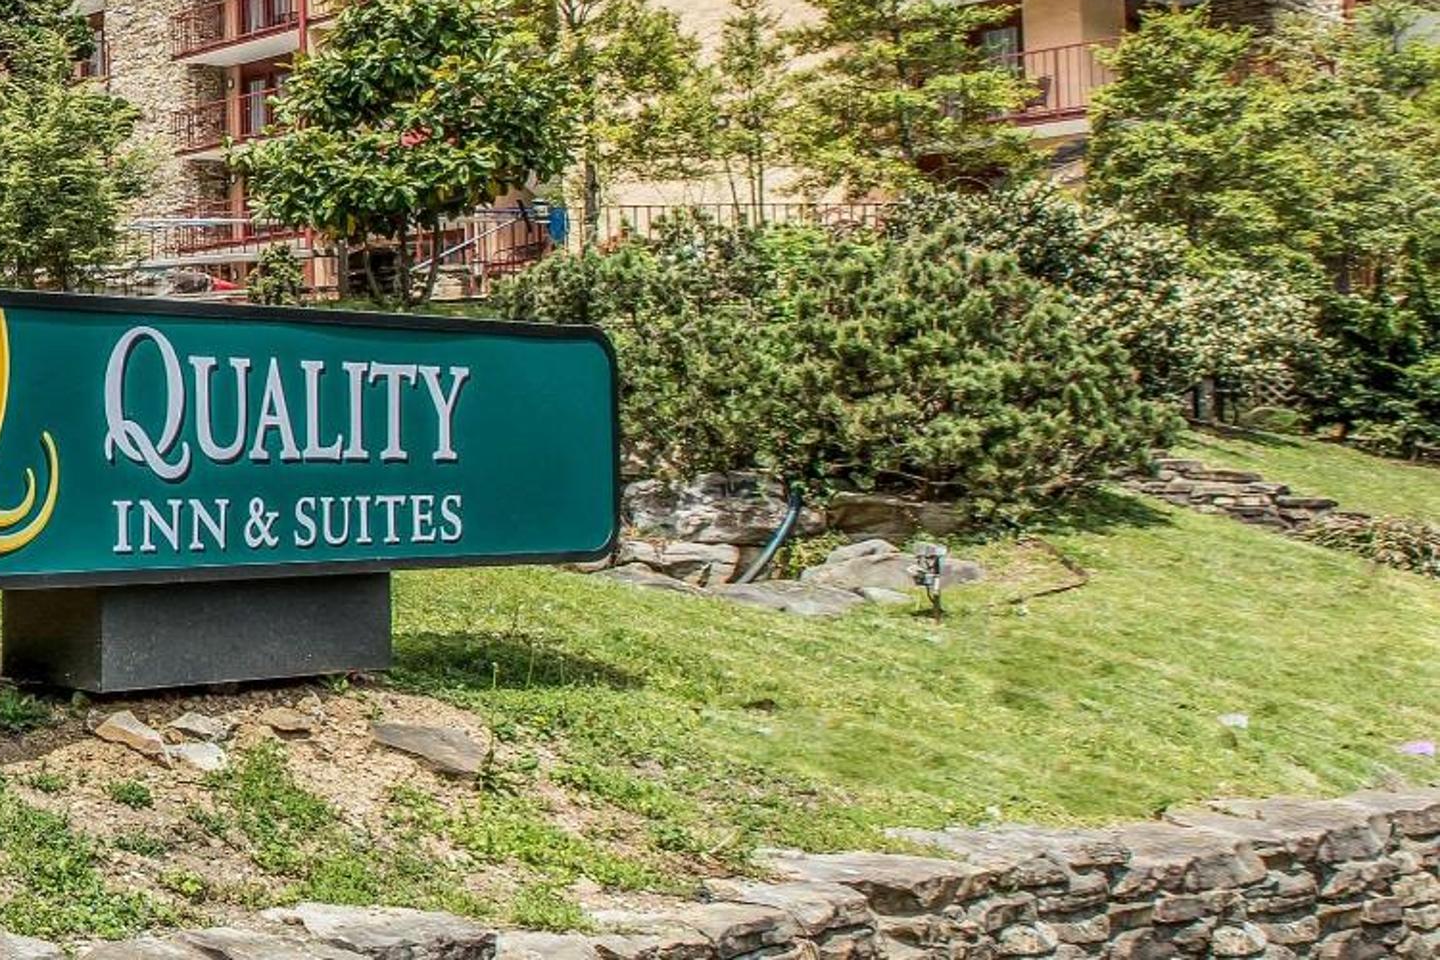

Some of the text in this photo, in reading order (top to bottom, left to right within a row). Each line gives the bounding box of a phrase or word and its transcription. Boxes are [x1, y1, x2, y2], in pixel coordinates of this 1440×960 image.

[105, 325, 470, 480] QUALITY
[112, 494, 462, 552] INN & SUITES
